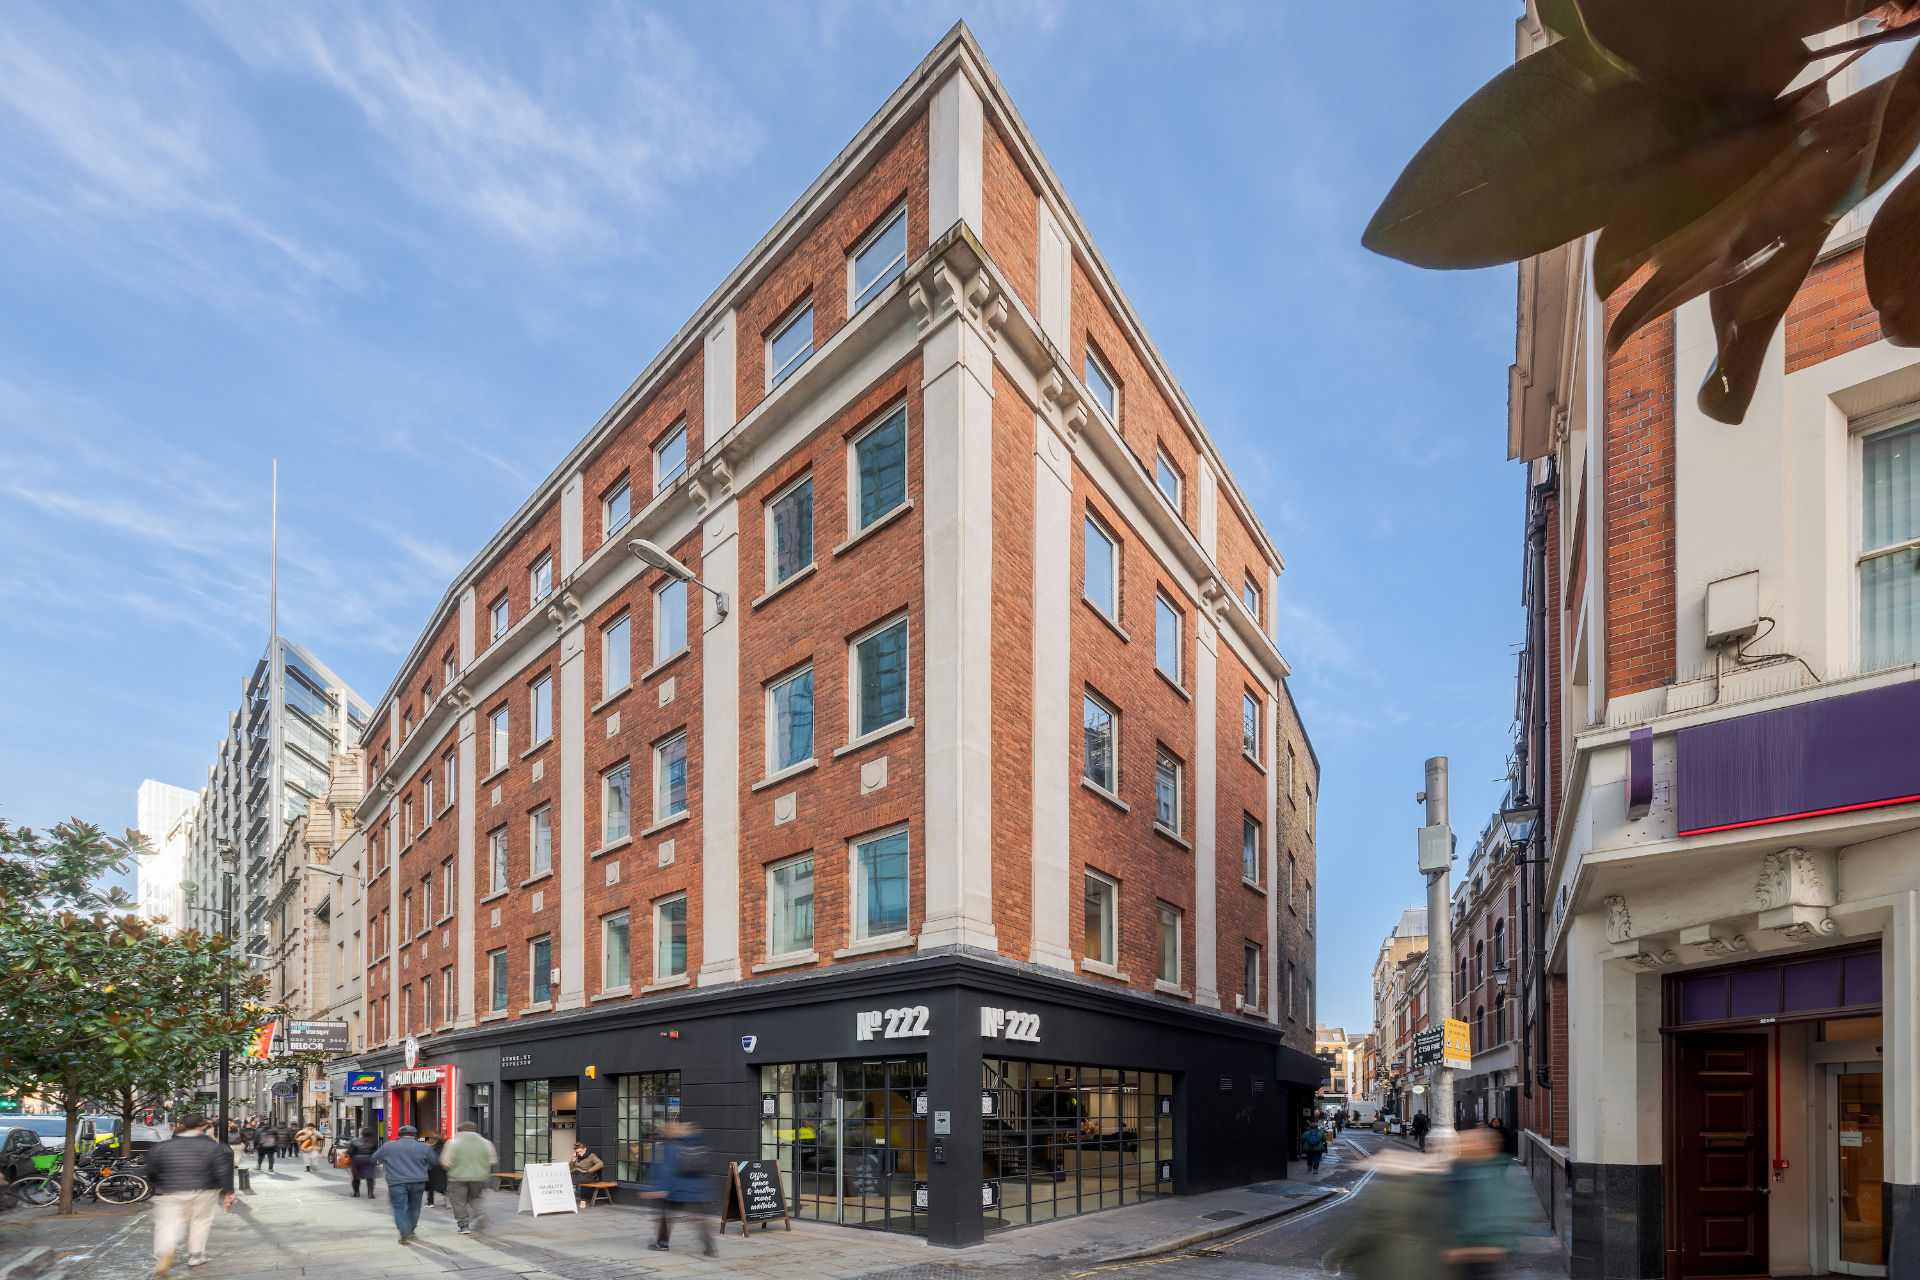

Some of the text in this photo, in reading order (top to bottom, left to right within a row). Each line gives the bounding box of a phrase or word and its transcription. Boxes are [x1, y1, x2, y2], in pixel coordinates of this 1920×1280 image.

[884, 1005, 931, 1039] 222
[1005, 1010, 1041, 1043] 222
[290, 1042, 324, 1050] BELCOR
